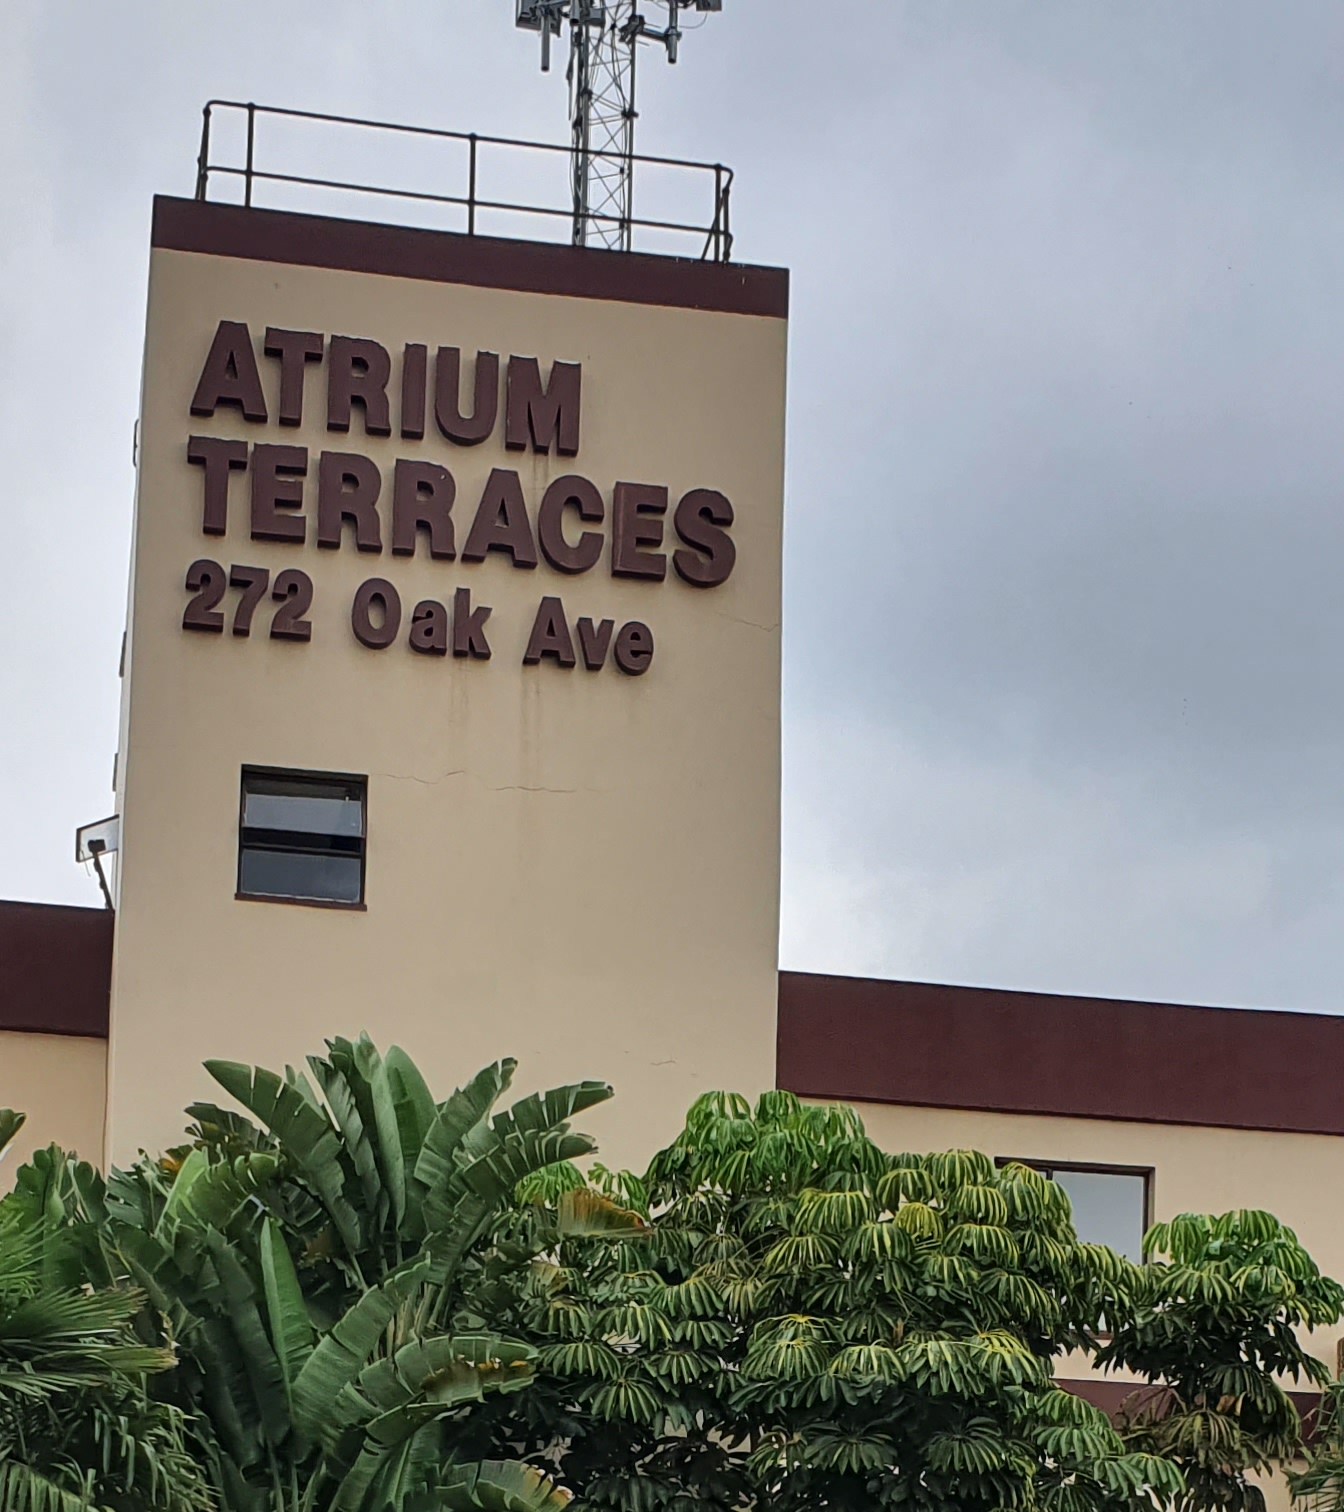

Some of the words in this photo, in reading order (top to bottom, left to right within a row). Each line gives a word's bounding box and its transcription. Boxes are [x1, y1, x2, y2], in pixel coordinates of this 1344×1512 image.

[189, 320, 582, 457] ATRIUM
[187, 435, 737, 588] TERRACES
[182, 559, 314, 642] 272
[351, 577, 492, 660] Oak
[523, 596, 654, 676] Ave
